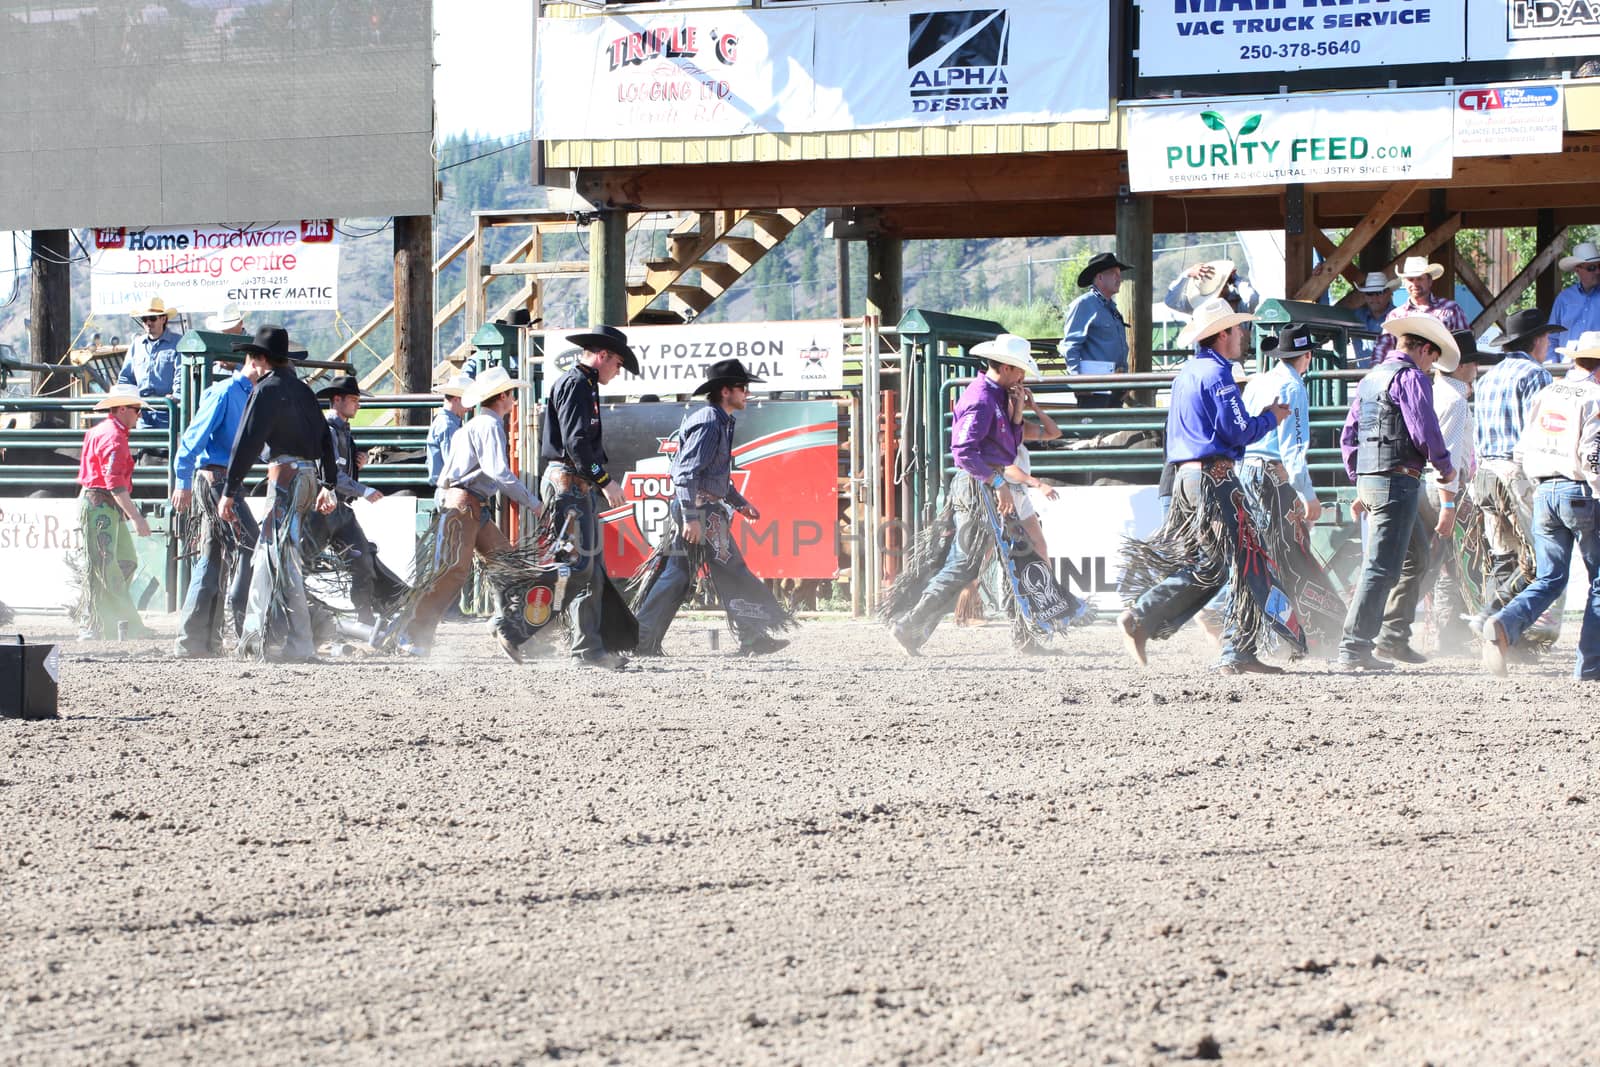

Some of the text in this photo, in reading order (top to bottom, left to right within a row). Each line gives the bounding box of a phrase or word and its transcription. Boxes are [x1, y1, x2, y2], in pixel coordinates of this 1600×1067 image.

[1176, 9, 1431, 36] VAC TRUCK SERVICE
[606, 26, 699, 71] TRIPLE
[1240, 40, 1361, 60] 250-378-5640
[909, 68, 1009, 88] ALPHA
[618, 81, 692, 102] LOGGING
[912, 97, 1009, 112] DESIGN
[1166, 139, 1280, 169] PURITY
[1169, 175, 1208, 184] SERVING
[1211, 173, 1230, 182] THE
[1359, 165, 1388, 174] SINCE
[129, 231, 189, 251] Home
[193, 229, 297, 250] hardware
[137, 253, 297, 277] building centre
[164, 279, 191, 288] Owned
[192, 279, 199, 287] &
[241, 276, 288, 286] 0-378-4215
[660, 340, 783, 359] POZZOBON
